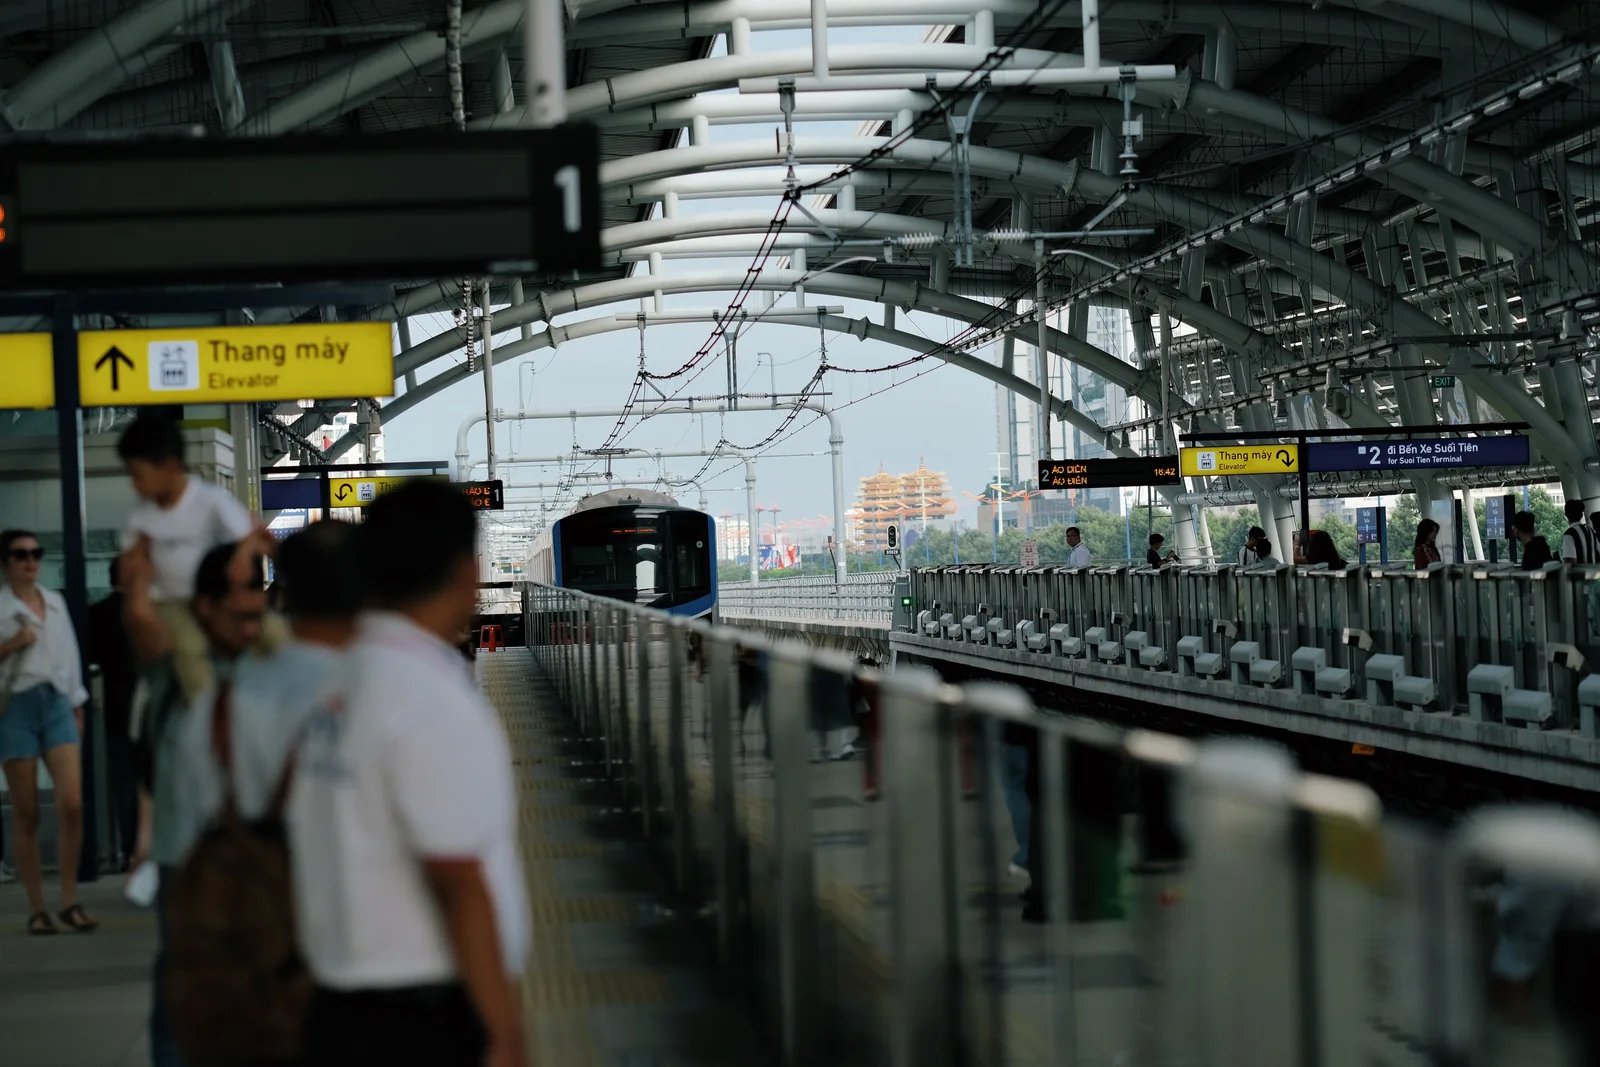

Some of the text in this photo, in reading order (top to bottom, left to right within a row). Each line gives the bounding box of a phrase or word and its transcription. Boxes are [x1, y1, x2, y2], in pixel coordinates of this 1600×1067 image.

[553, 165, 582, 233] 1
[208, 336, 350, 367] Thang máy
[208, 372, 279, 389] Elevator
[1434, 377, 1451, 386] EXIT
[1219, 449, 1273, 461] Thang máy
[1387, 442, 1479, 455] đi Bến Xe Suối Tiên
[1369, 446, 1381, 465] 2
[1387, 455, 1463, 465] for Suoi Tien Terminal
[1041, 469, 1050, 482] 2
[1154, 467, 1176, 476] 16:42
[494, 488, 500, 502] 1
